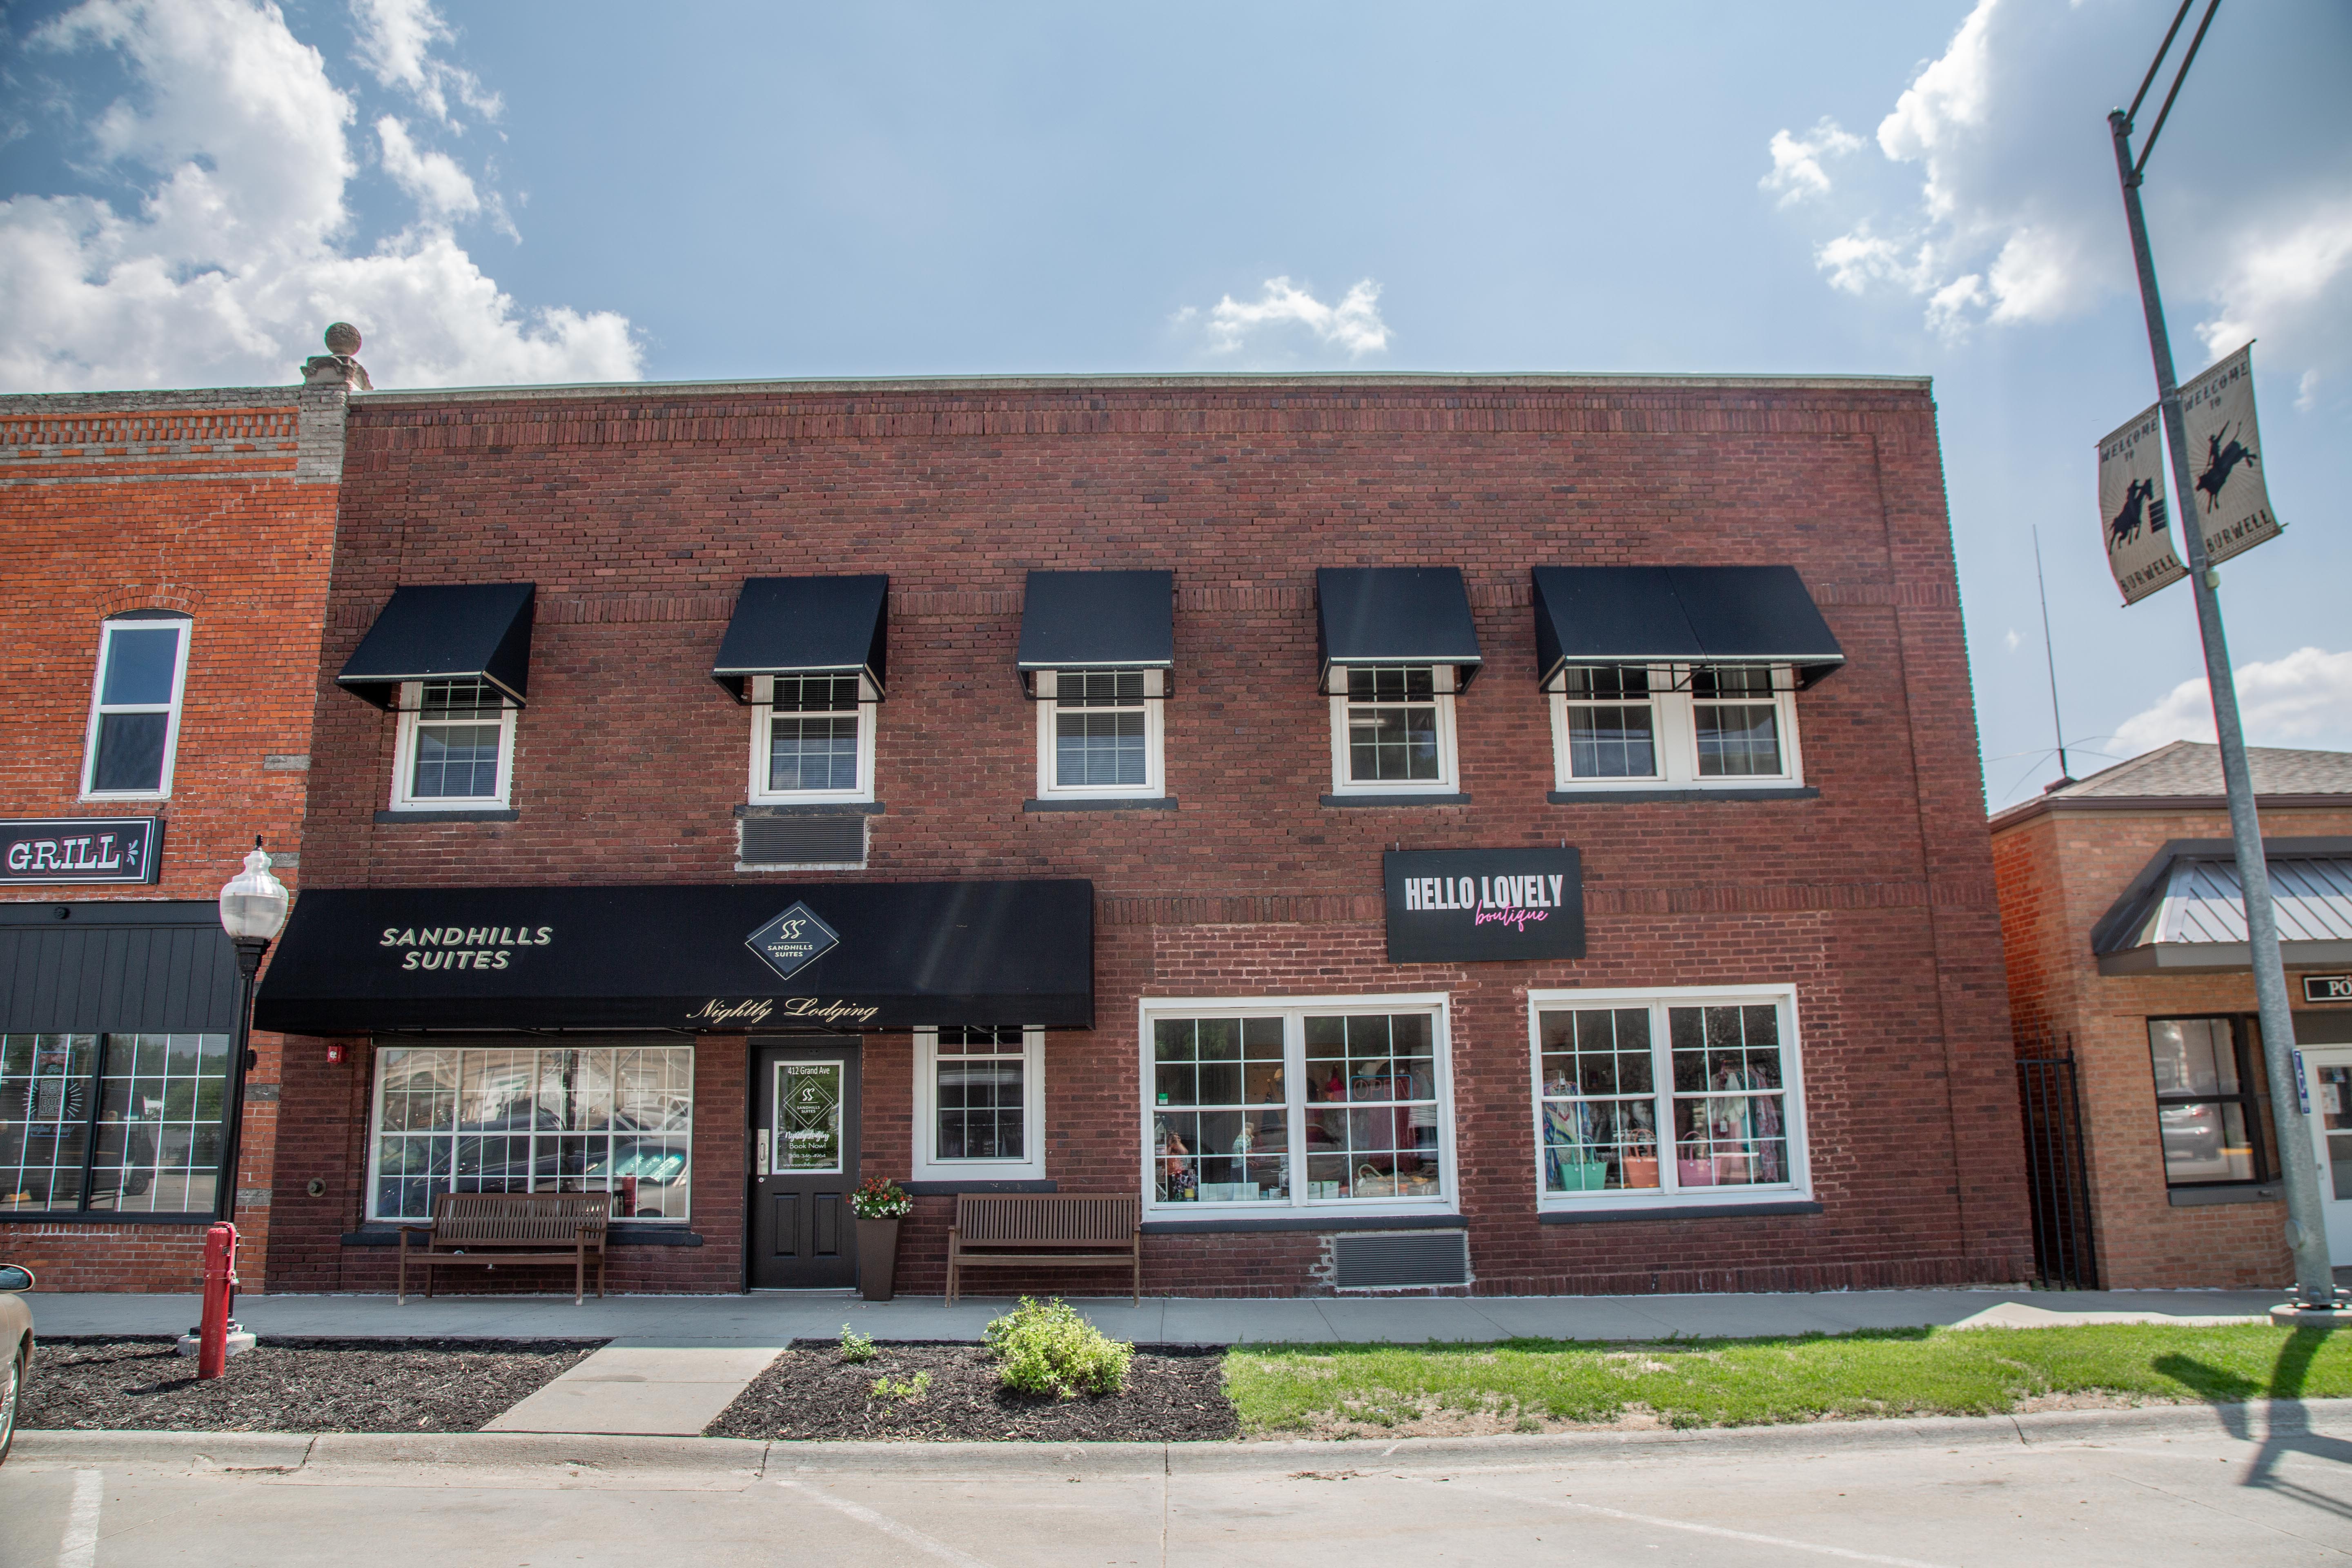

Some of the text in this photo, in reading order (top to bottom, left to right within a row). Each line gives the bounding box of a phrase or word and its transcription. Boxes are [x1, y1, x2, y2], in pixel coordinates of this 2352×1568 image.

[2184, 361, 2248, 412] WELCOME
[2210, 396, 2221, 410] TO
[2100, 418, 2158, 463] WELCOME
[2124, 449, 2134, 462] TO
[2206, 509, 2271, 552] BURWELL
[2119, 554, 2178, 592] BURWELL
[9, 835, 120, 870] GRILL
[1405, 875, 1564, 910] HELLO LOVELY
[1475, 899, 1549, 932] boutique
[380, 927, 553, 946] SANDHILLS
[402, 950, 511, 970] SUITES
[686, 998, 879, 1024] Nightly Lodging
[788, 1066, 830, 1075] 412 Grand Ave
[1354, 1079, 1410, 1099] OPEN
[39, 1106, 61, 1114] LIGH
[42, 1098, 61, 1106] BUD
[785, 1131, 830, 1142] Nightly Lodging
